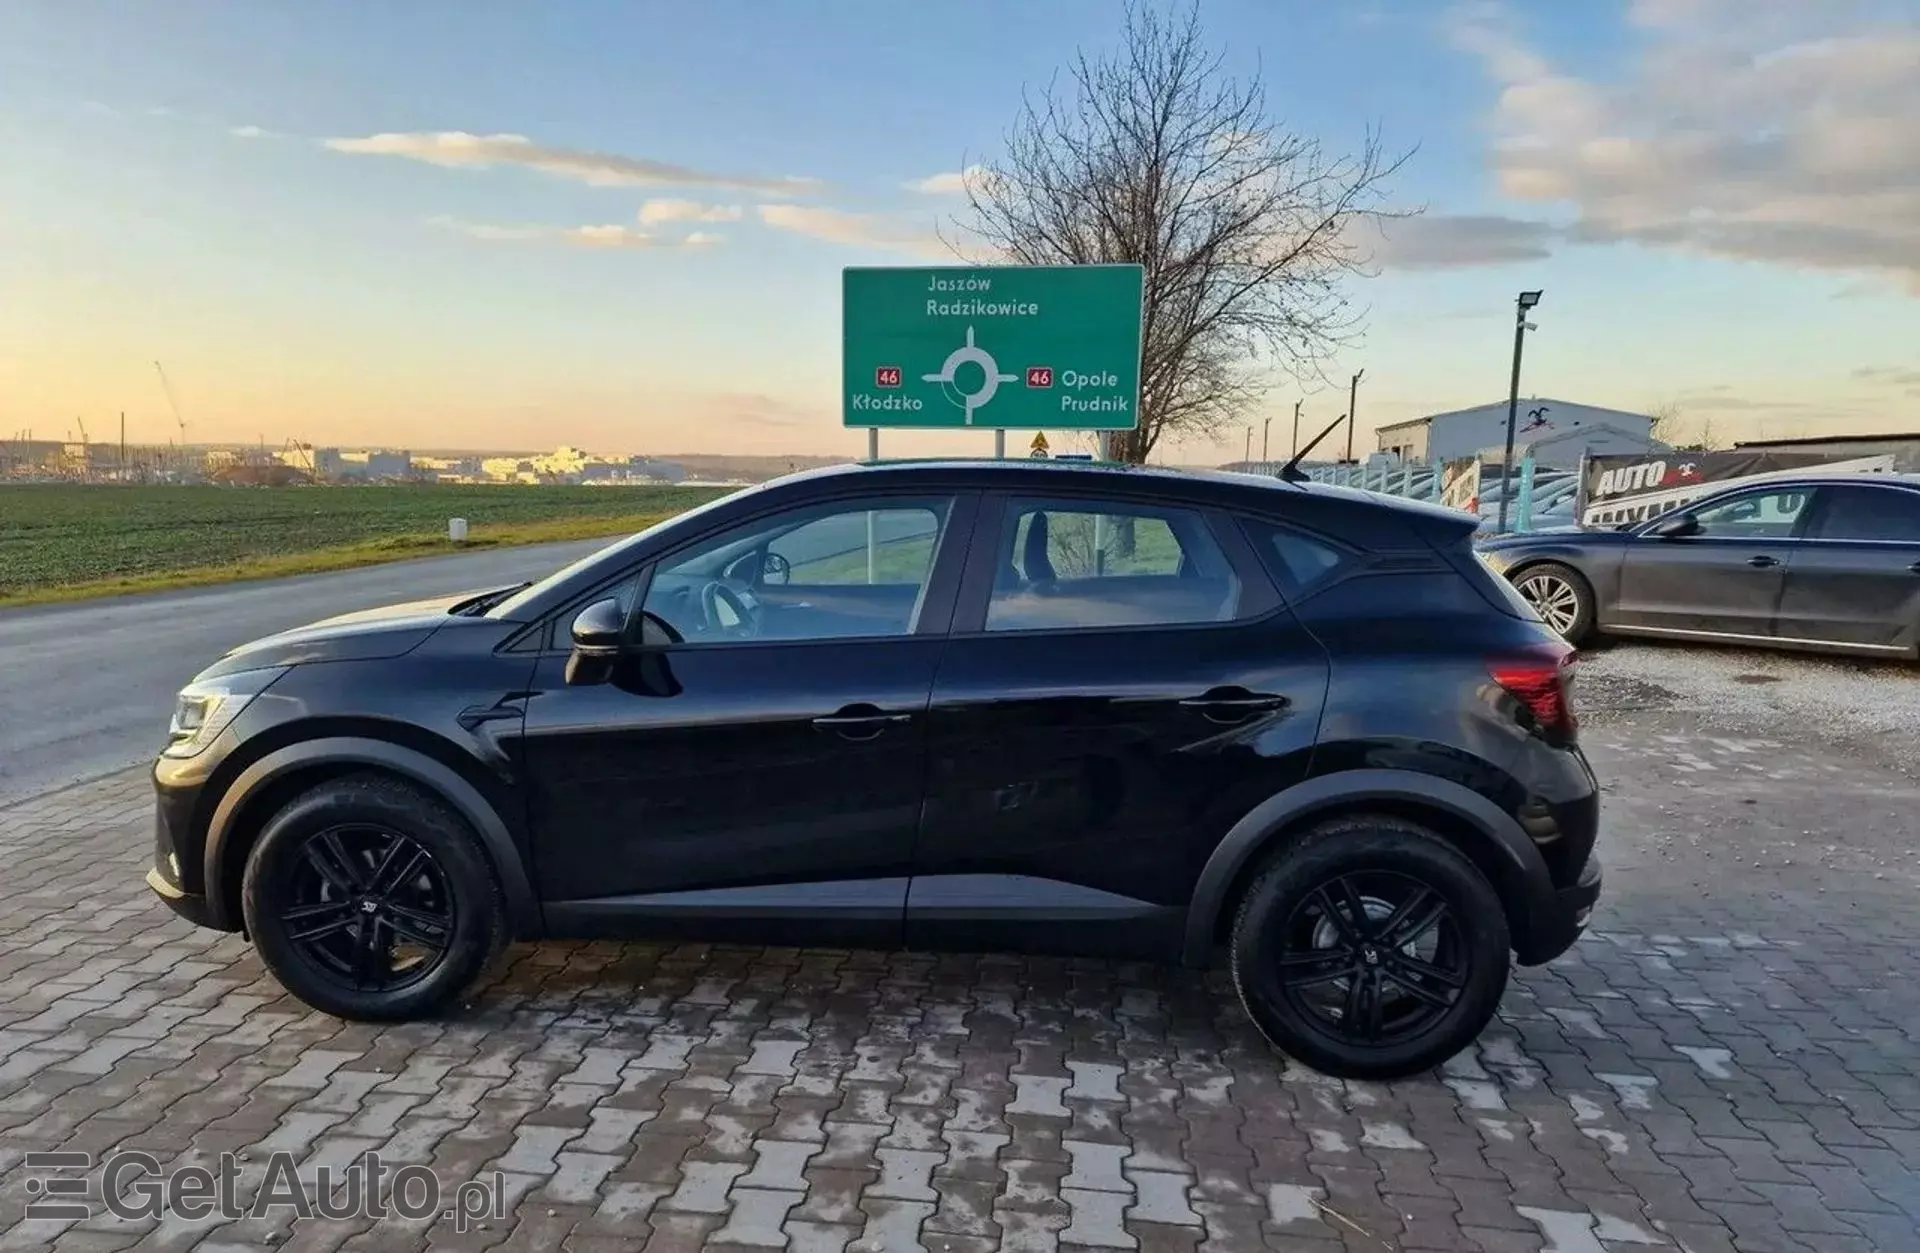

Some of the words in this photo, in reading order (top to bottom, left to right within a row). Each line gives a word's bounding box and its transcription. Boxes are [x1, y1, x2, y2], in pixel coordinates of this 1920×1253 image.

[928, 274, 991, 292] Jaszów
[926, 300, 1039, 316] Radzikowice
[879, 371, 898, 384] 46
[1030, 371, 1049, 384] 46
[1062, 370, 1118, 391] Opole
[852, 395, 923, 411] Kłodzko
[1061, 396, 1129, 412] Prudnik
[1596, 461, 1667, 495] AUTO
